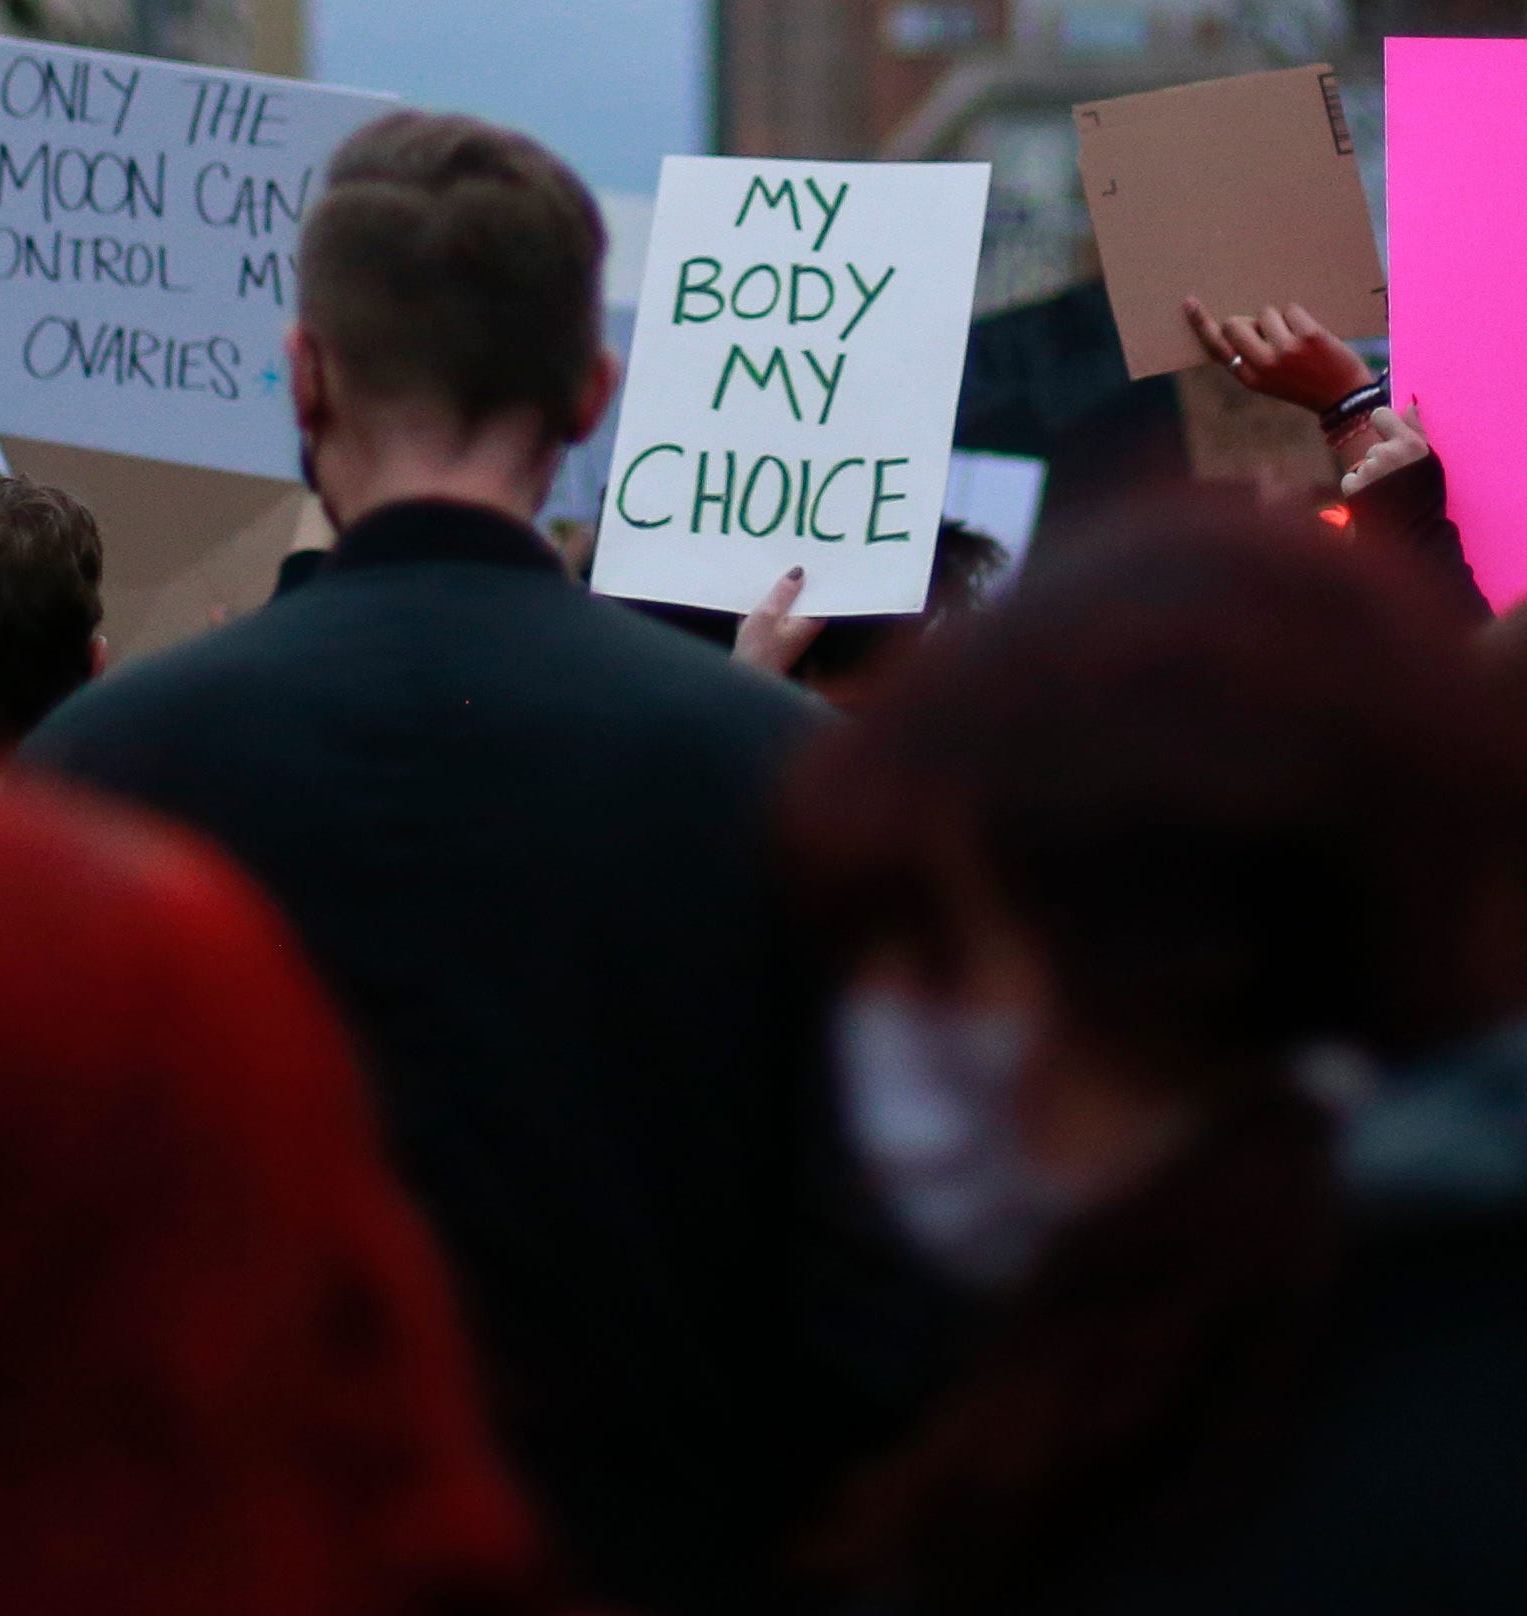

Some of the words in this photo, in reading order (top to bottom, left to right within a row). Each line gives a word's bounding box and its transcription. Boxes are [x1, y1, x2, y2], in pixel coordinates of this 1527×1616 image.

[1, 55, 140, 136] ONLY
[182, 80, 289, 147] THE
[194, 161, 312, 237] CAN
[735, 175, 849, 252] MY
[238, 250, 298, 306] M
[672, 256, 896, 341] BODY
[22, 316, 241, 400] OVARIES
[711, 344, 847, 425] MY
[616, 443, 911, 545] CHOICE
